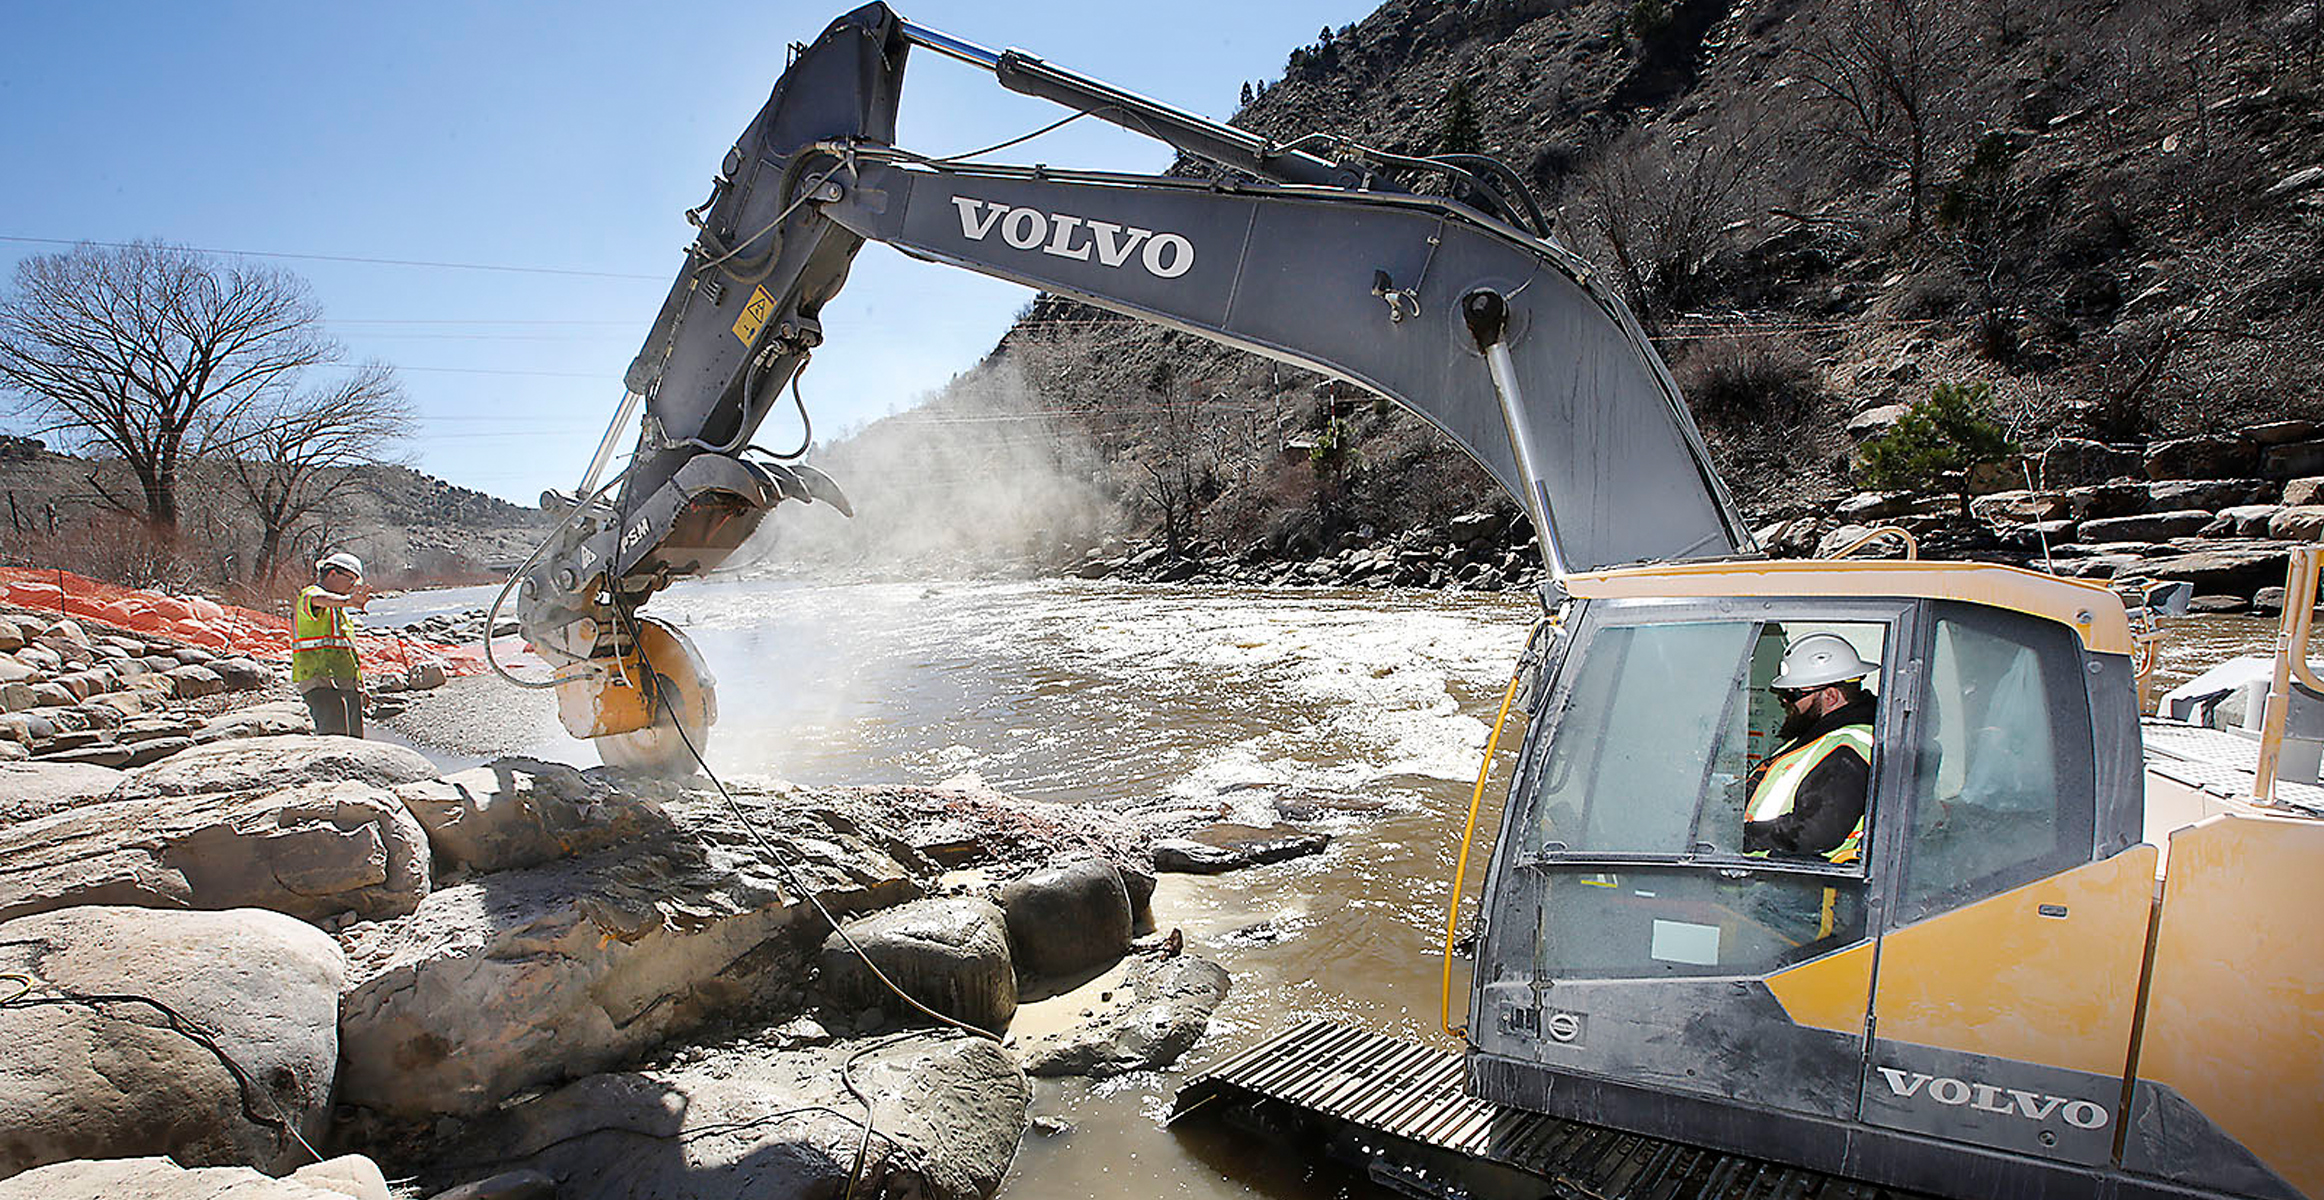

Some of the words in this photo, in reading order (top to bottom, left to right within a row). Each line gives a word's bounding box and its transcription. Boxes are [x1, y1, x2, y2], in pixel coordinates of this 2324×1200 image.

[951, 195, 1195, 278] VOLVO
[620, 516, 651, 555] PSM
[1877, 1066, 2109, 1129] VOLVO
